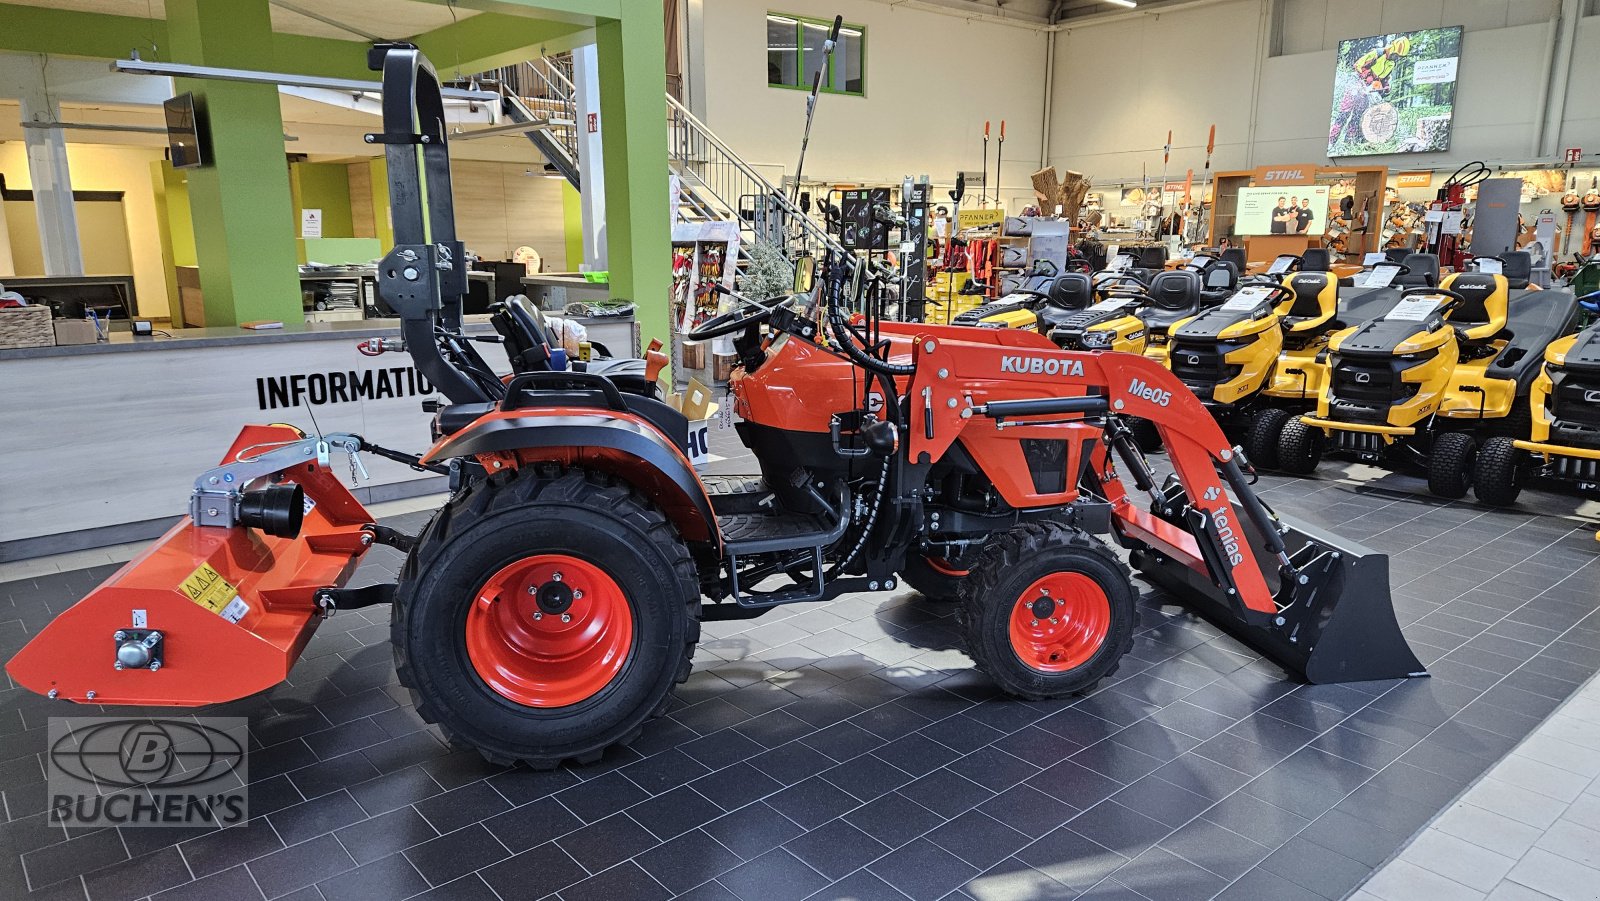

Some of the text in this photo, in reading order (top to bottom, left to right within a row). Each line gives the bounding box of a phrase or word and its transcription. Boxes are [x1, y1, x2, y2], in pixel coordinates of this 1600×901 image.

[1264, 169, 1305, 181] STIHL
[959, 213, 994, 221] PFANNER
[1001, 355, 1084, 377] KUBOTA
[256, 366, 442, 410] INFORMATIO
[1128, 378, 1172, 407] Me05
[1211, 506, 1244, 567] tenias
